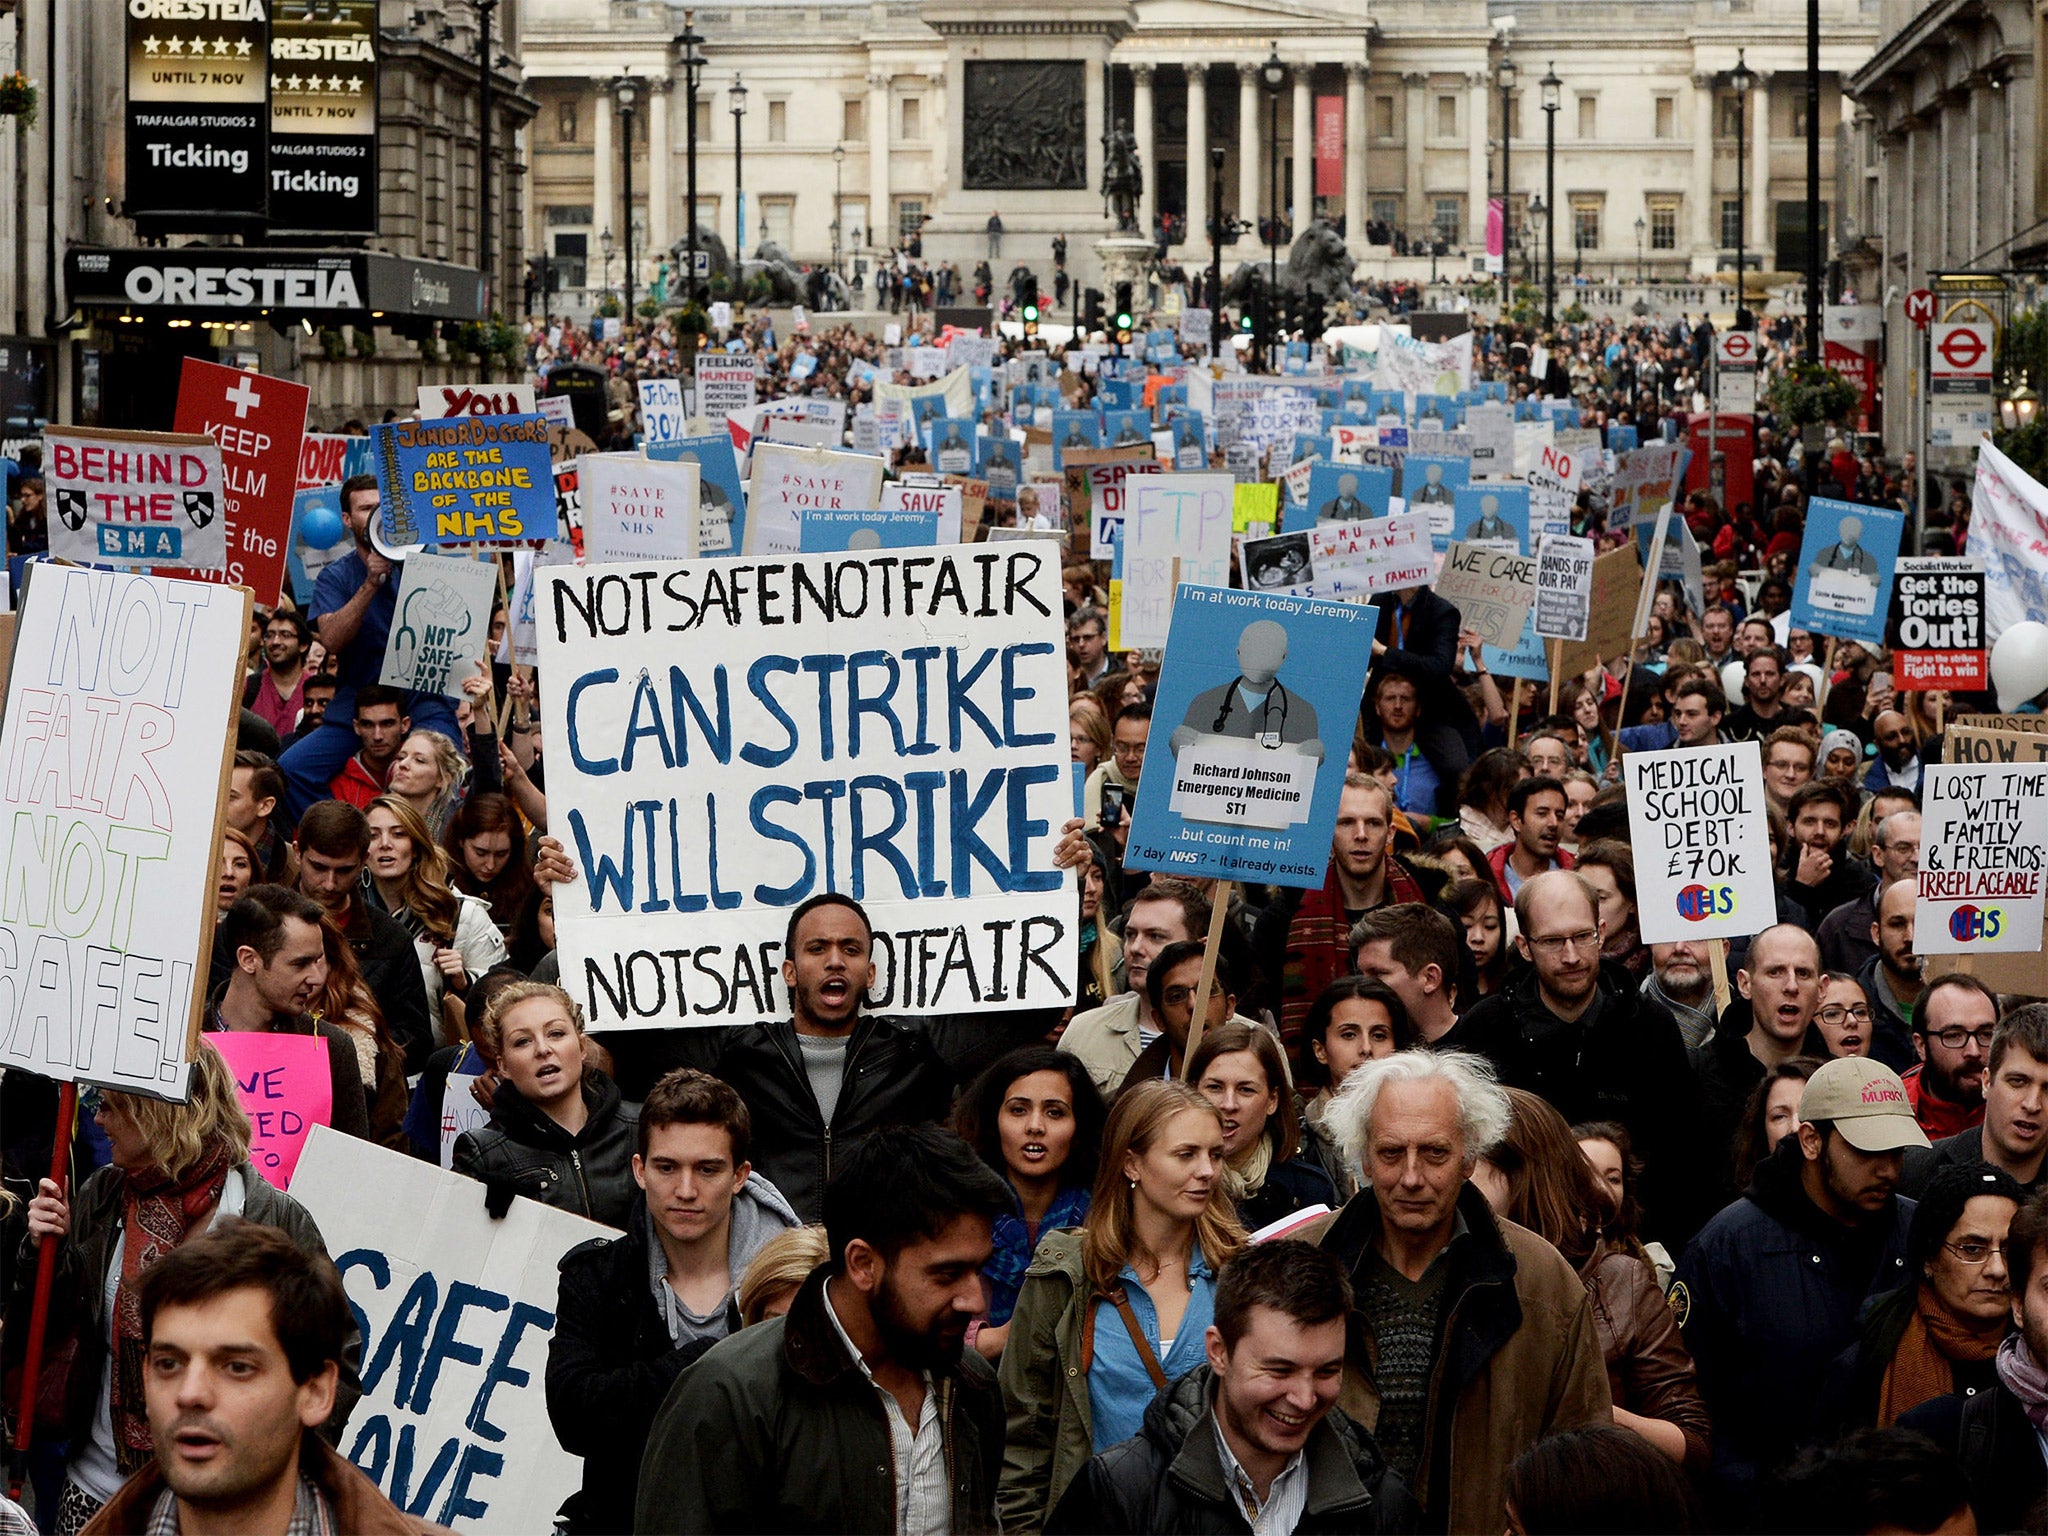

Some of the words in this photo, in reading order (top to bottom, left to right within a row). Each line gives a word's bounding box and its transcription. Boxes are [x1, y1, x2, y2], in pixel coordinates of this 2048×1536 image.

[129, 0, 266, 21] ORESTEIA
[271, 38, 375, 62] RESTEIA
[152, 72, 196, 84] UNTIL
[200, 73, 207, 84] 7
[212, 74, 244, 84] NOV
[135, 115, 198, 127] TRAFALGAR
[200, 116, 246, 127] STUDIOS
[249, 117, 256, 127] 2
[274, 107, 313, 117] UNTIL
[316, 107, 323, 117] 7
[327, 108, 356, 118] NOV
[146, 143, 249, 174] Ticking
[316, 146, 357, 156] STUDIOS
[359, 147, 366, 157] 2
[271, 170, 359, 198] Ticking
[124, 265, 361, 308] ORESTEIA
[1910, 294, 1933, 318] M
[699, 357, 754, 368] FEELING
[699, 371, 754, 382] HUNTED
[705, 383, 747, 391] PROTECT
[440, 387, 520, 417] YOU
[705, 393, 748, 401] DOCTORS
[705, 402, 747, 410] PROTECT
[203, 420, 271, 458] KEEP
[397, 421, 469, 448] JUNIOR
[468, 418, 548, 446] DOCTORS
[54, 444, 207, 487] BEHIND
[426, 451, 460, 469] ARE
[464, 448, 502, 465] THE
[1542, 447, 1571, 478] NO
[221, 463, 267, 498] ALM
[413, 467, 533, 493] BACKBONE
[782, 473, 845, 492] #SAVE
[432, 493, 457, 508] OF
[470, 491, 511, 507] THE
[610, 485, 665, 500] #SAVE
[781, 491, 842, 509] YOUR
[901, 493, 946, 516] SAVE
[94, 493, 175, 523] THE
[224, 500, 240, 513] ND
[610, 502, 665, 519] YOUR
[806, 511, 822, 520] I'm
[824, 512, 834, 520] at
[835, 511, 860, 521] work
[862, 511, 887, 523] today
[436, 509, 524, 538] NHS
[620, 521, 654, 535] NHS
[1137, 487, 1227, 552] FTP
[103, 528, 174, 555] BMA
[243, 528, 277, 557] the
[1127, 558, 1166, 587] FOR
[1385, 567, 1428, 585] FAMILY!
[1452, 545, 1486, 573] WE
[1490, 556, 1537, 585] CARE
[1541, 556, 1570, 573] HANDS
[1574, 561, 1589, 575] OFF
[1904, 561, 1940, 571] Socialist
[1942, 561, 1973, 570] Worker
[1539, 572, 1557, 588] OUR
[1561, 575, 1579, 590] PAY
[1899, 576, 1937, 595] Get
[1941, 576, 1978, 595] the
[1184, 587, 1206, 602] I'm
[1209, 591, 1224, 604] at
[1226, 593, 1261, 609] work
[1265, 599, 1302, 615] today
[1899, 594, 1979, 617] Tories
[48, 571, 212, 708] NOT
[424, 625, 456, 646] NOT
[1900, 616, 1978, 648] Out!
[419, 650, 453, 668] SAFE
[1904, 663, 1936, 679] Fight
[1939, 664, 1952, 677] to
[1956, 663, 1978, 677] win
[415, 664, 450, 683] NOT
[413, 678, 450, 696] FAIR
[567, 663, 731, 776] CAN
[739, 643, 1056, 768] STRIKE
[6, 688, 174, 832] FAIR
[1953, 737, 2018, 763] HOW
[1193, 763, 1240, 780] Richard
[1241, 768, 1292, 784] Johnson
[1638, 754, 1745, 791] MEDICAL
[1177, 779, 1244, 799] Emergency
[1246, 788, 1301, 803] Medicine
[1932, 774, 1987, 801] LOST
[2001, 773, 2047, 797] TIME
[1225, 802, 1247, 816] ST1
[1644, 787, 1752, 821] SCHOOL
[1963, 799, 2020, 821] WITH
[568, 792, 742, 913] WILL
[749, 764, 1063, 907] STRIKE
[1207, 830, 1245, 846] count
[1248, 837, 1270, 849] me
[1273, 838, 1292, 852] in!
[1665, 818, 1744, 850] DEBT:
[1943, 820, 2023, 845] FAMILY
[1133, 845, 1141, 857] 7
[1143, 847, 1166, 862] day
[1169, 850, 1198, 864] NHS
[1219, 855, 1228, 867] It
[1230, 855, 1277, 875] already
[1279, 865, 1317, 877] exists.
[1928, 844, 1945, 871] &
[1953, 844, 2046, 871] FRIENDS:
[3, 811, 171, 953] NOT
[1917, 871, 2040, 898] IRREPLACEABLE
[1676, 886, 1734, 918] NHS
[1951, 909, 2001, 939] NHS
[1861, 1090, 1904, 1103] MURKY
[335, 1249, 556, 1442] SAFE
[349, 1413, 505, 1526] AVE
